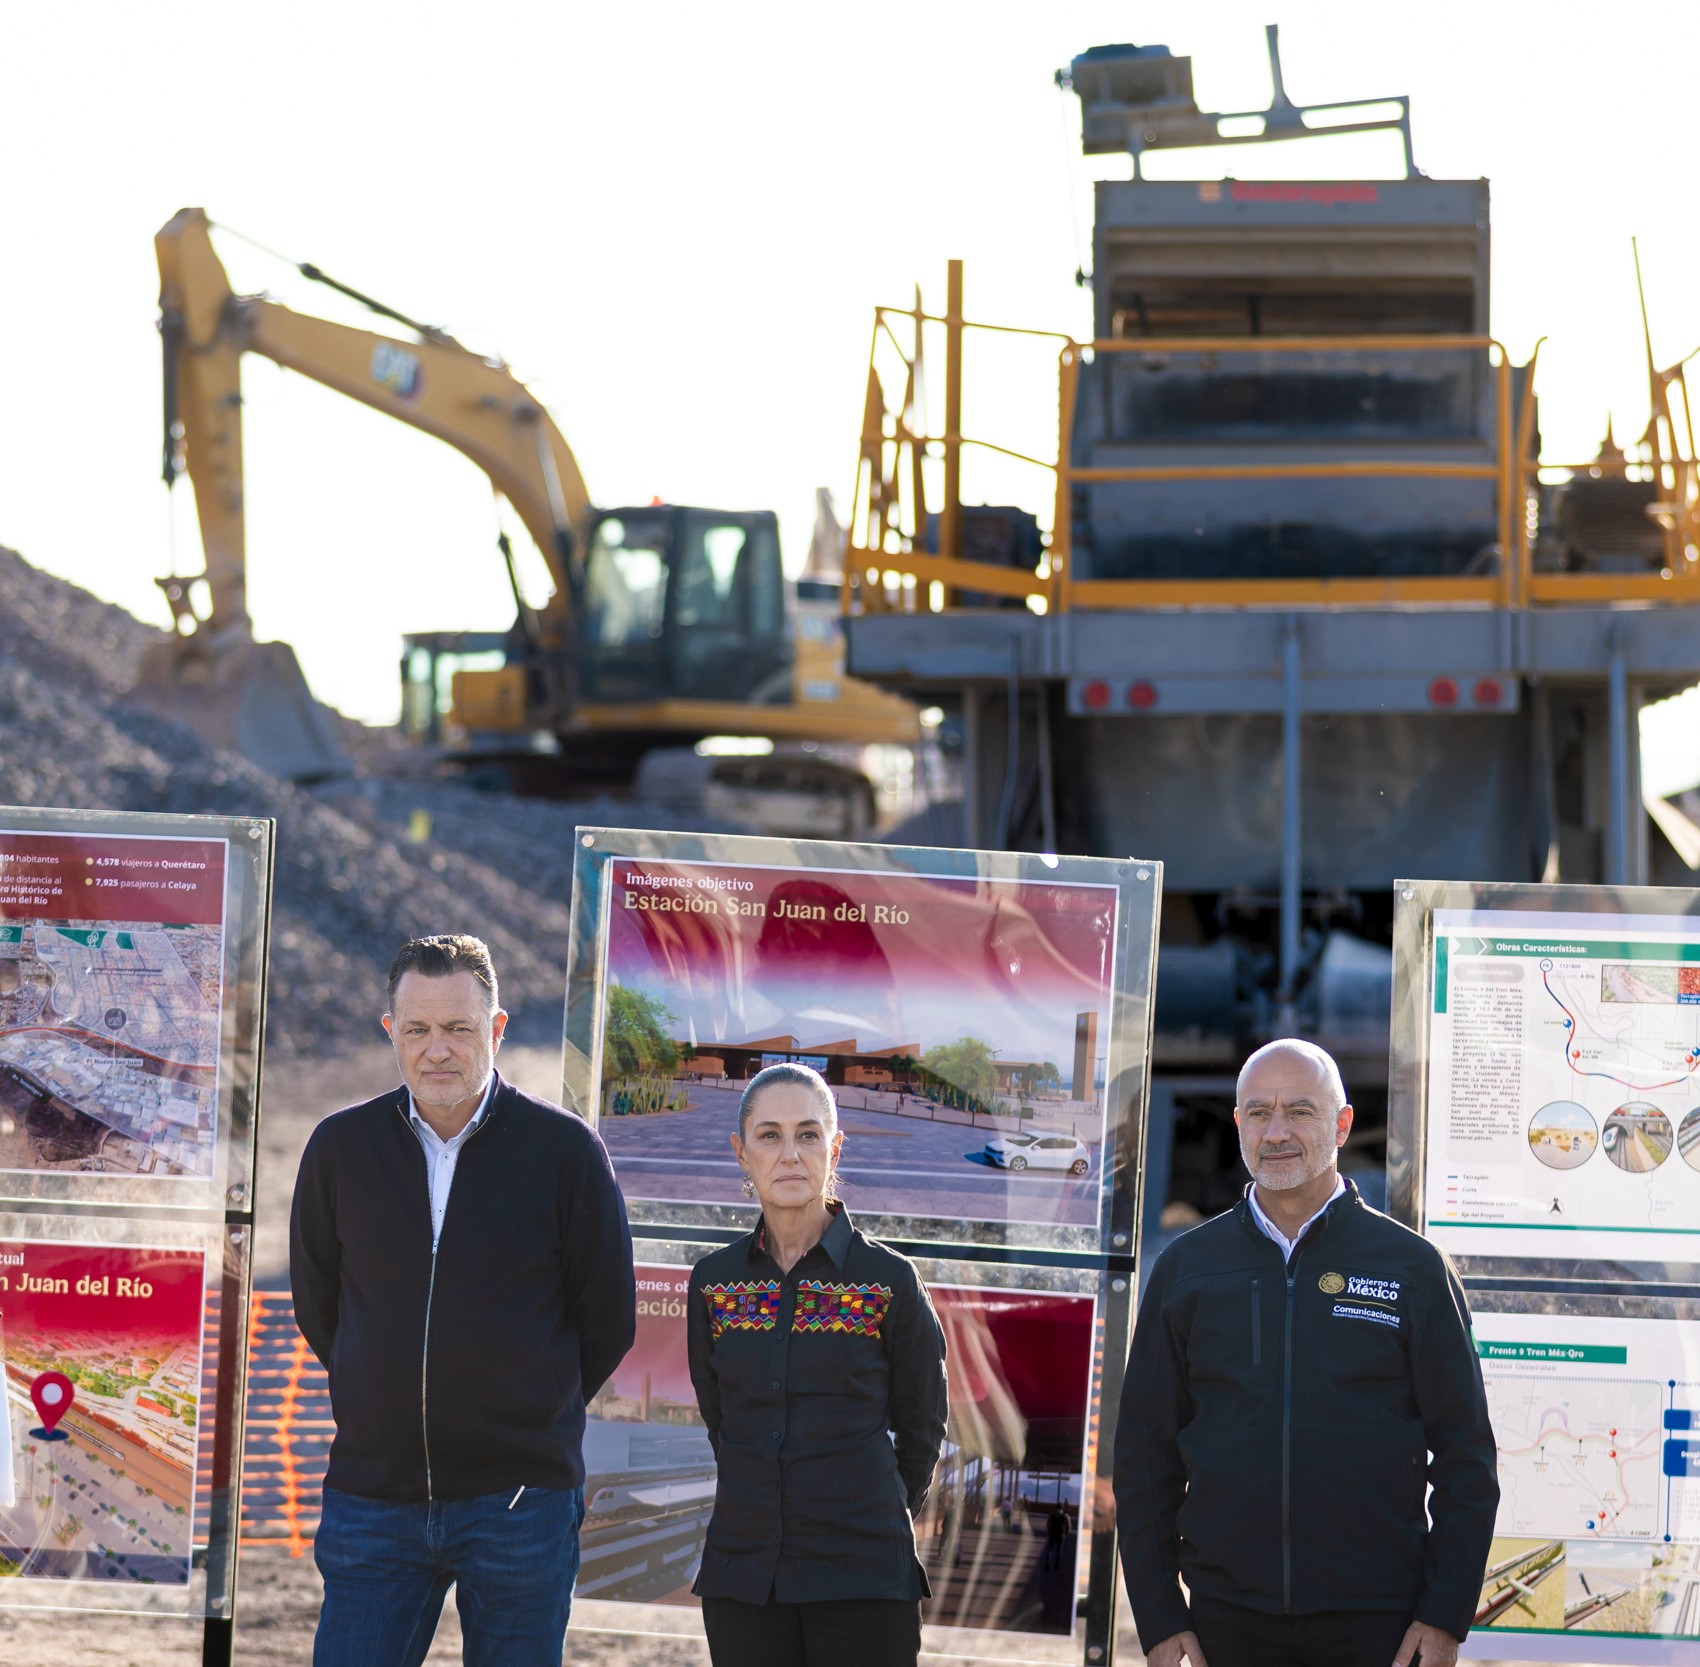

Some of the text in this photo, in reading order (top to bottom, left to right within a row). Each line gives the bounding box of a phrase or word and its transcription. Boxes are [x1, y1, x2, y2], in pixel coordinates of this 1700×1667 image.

[16, 855, 59, 864] habitantes
[96, 858, 120, 867] 4,578
[121, 859, 152, 868] viajeros
[161, 860, 206, 870] Querétaro
[4, 874, 62, 885] de distancia al
[95, 878, 119, 888] 7,925
[120, 880, 159, 889] pasajeros
[168, 881, 197, 891] Celaya
[626, 872, 754, 892] Imágenes objetivo
[11, 885, 50, 894] Histórico
[52, 886, 63, 895] de
[18, 896, 32, 904] del
[34, 896, 48, 906] Río
[624, 890, 910, 924] Estación San Juan del Río
[1496, 943, 1520, 952] Obras
[16, 1273, 153, 1298] Juan del Río
[636, 1280, 670, 1292] enes
[1348, 1276, 1388, 1288] Gobierno
[1347, 1282, 1398, 1300] México
[1334, 1305, 1400, 1323] Comunicaciones
[1489, 1346, 1517, 1355] Frente
[1519, 1347, 1524, 1355] 9
[1527, 1348, 1546, 1356] Tren
[1516, 1363, 1556, 1371] Generales
